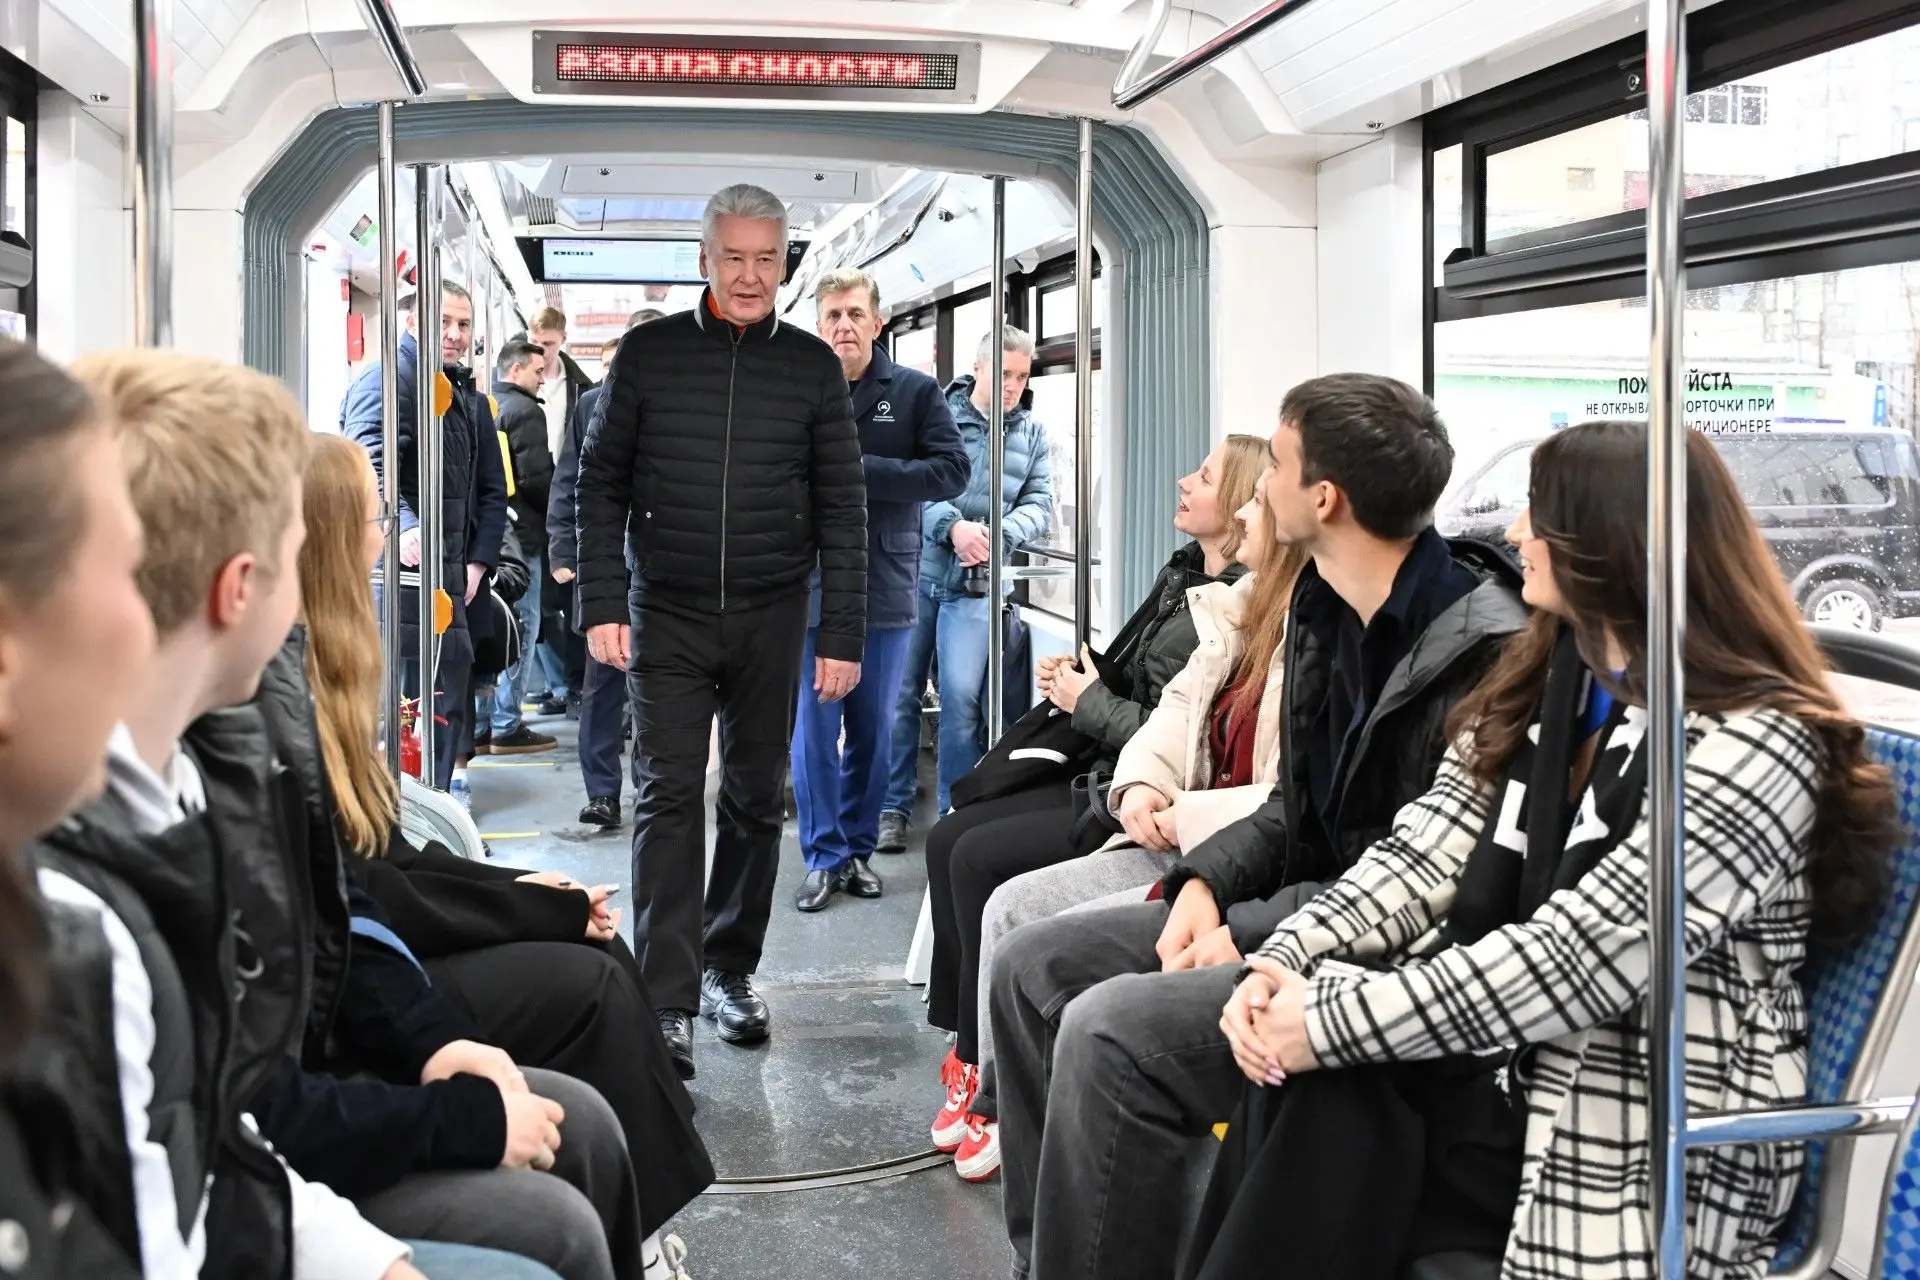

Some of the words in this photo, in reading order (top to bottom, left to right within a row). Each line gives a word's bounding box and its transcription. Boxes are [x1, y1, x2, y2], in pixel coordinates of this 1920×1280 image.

[1618, 369, 1733, 394] ПОЖЙСТА
[1586, 403, 1599, 415] НЕ
[1601, 402, 1649, 415] ОТКРЫВ
[1682, 399, 1744, 413] ОРТОЧКИ
[1748, 398, 1775, 412] ПРИ
